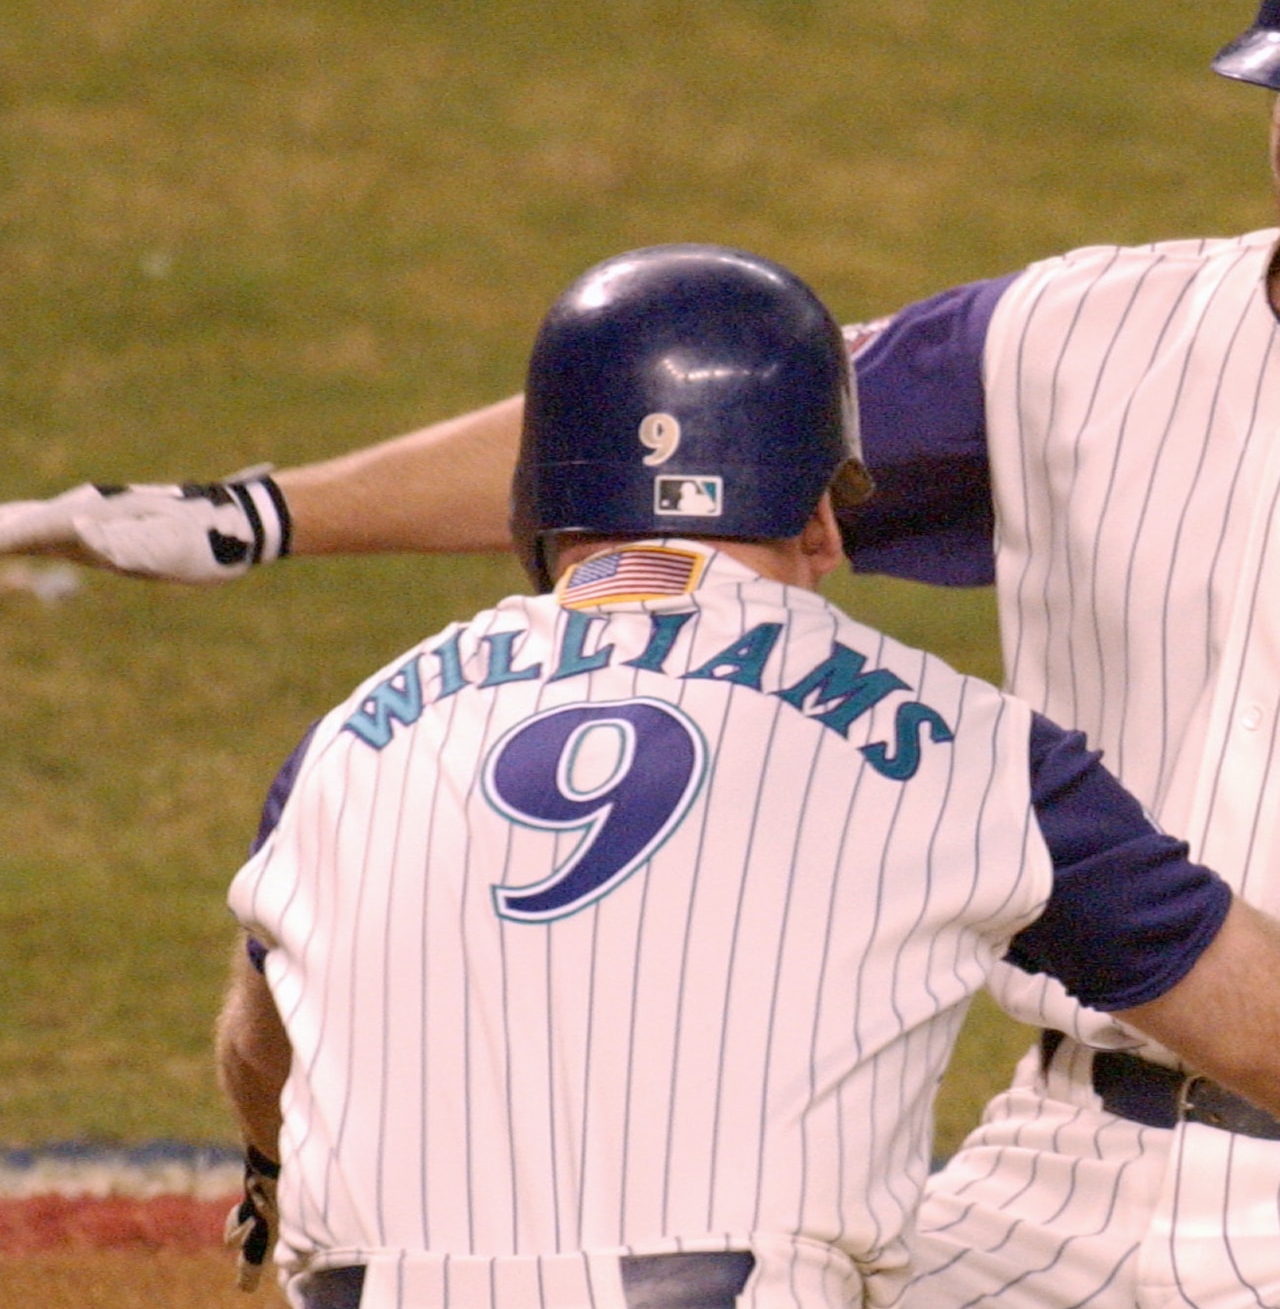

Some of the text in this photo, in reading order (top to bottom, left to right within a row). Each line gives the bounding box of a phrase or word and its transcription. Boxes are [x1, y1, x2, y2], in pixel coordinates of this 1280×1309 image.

[638, 412, 680, 466] 9
[342, 608, 955, 782] WILLIAMS
[481, 695, 709, 924] 9
